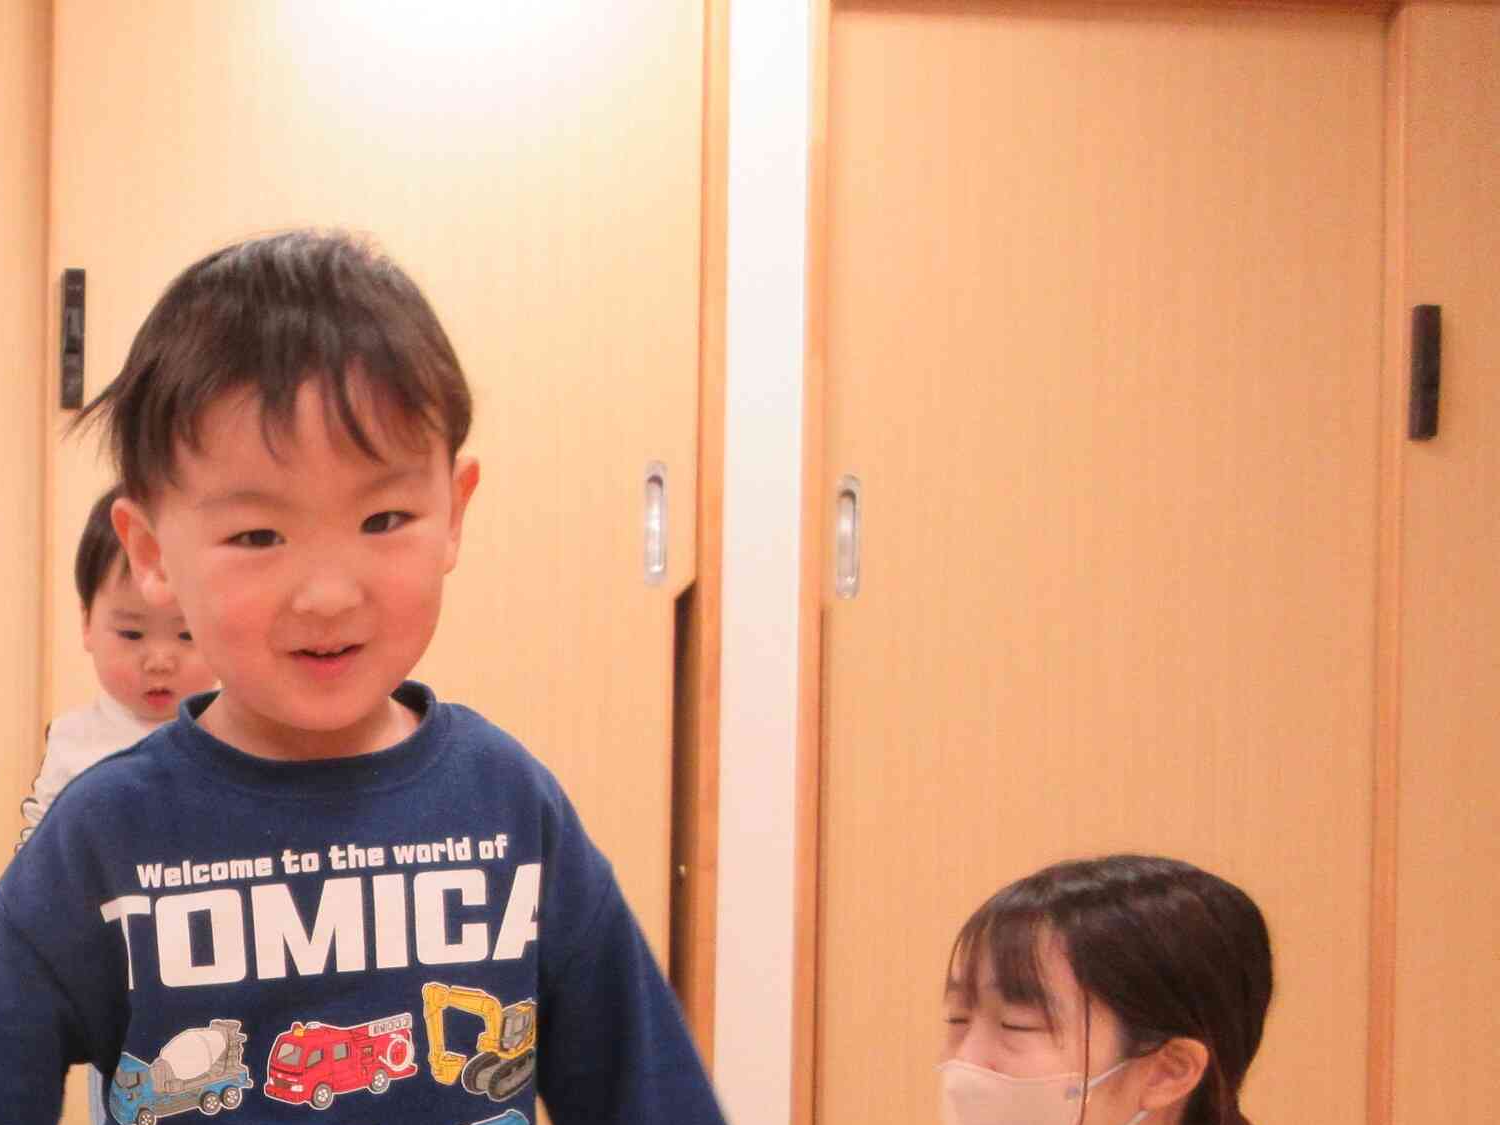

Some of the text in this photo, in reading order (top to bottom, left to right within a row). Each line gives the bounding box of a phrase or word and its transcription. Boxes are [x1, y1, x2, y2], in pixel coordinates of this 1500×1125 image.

[136, 833, 509, 889] Welcome to the world of
[100, 863, 541, 990] TOMICA
